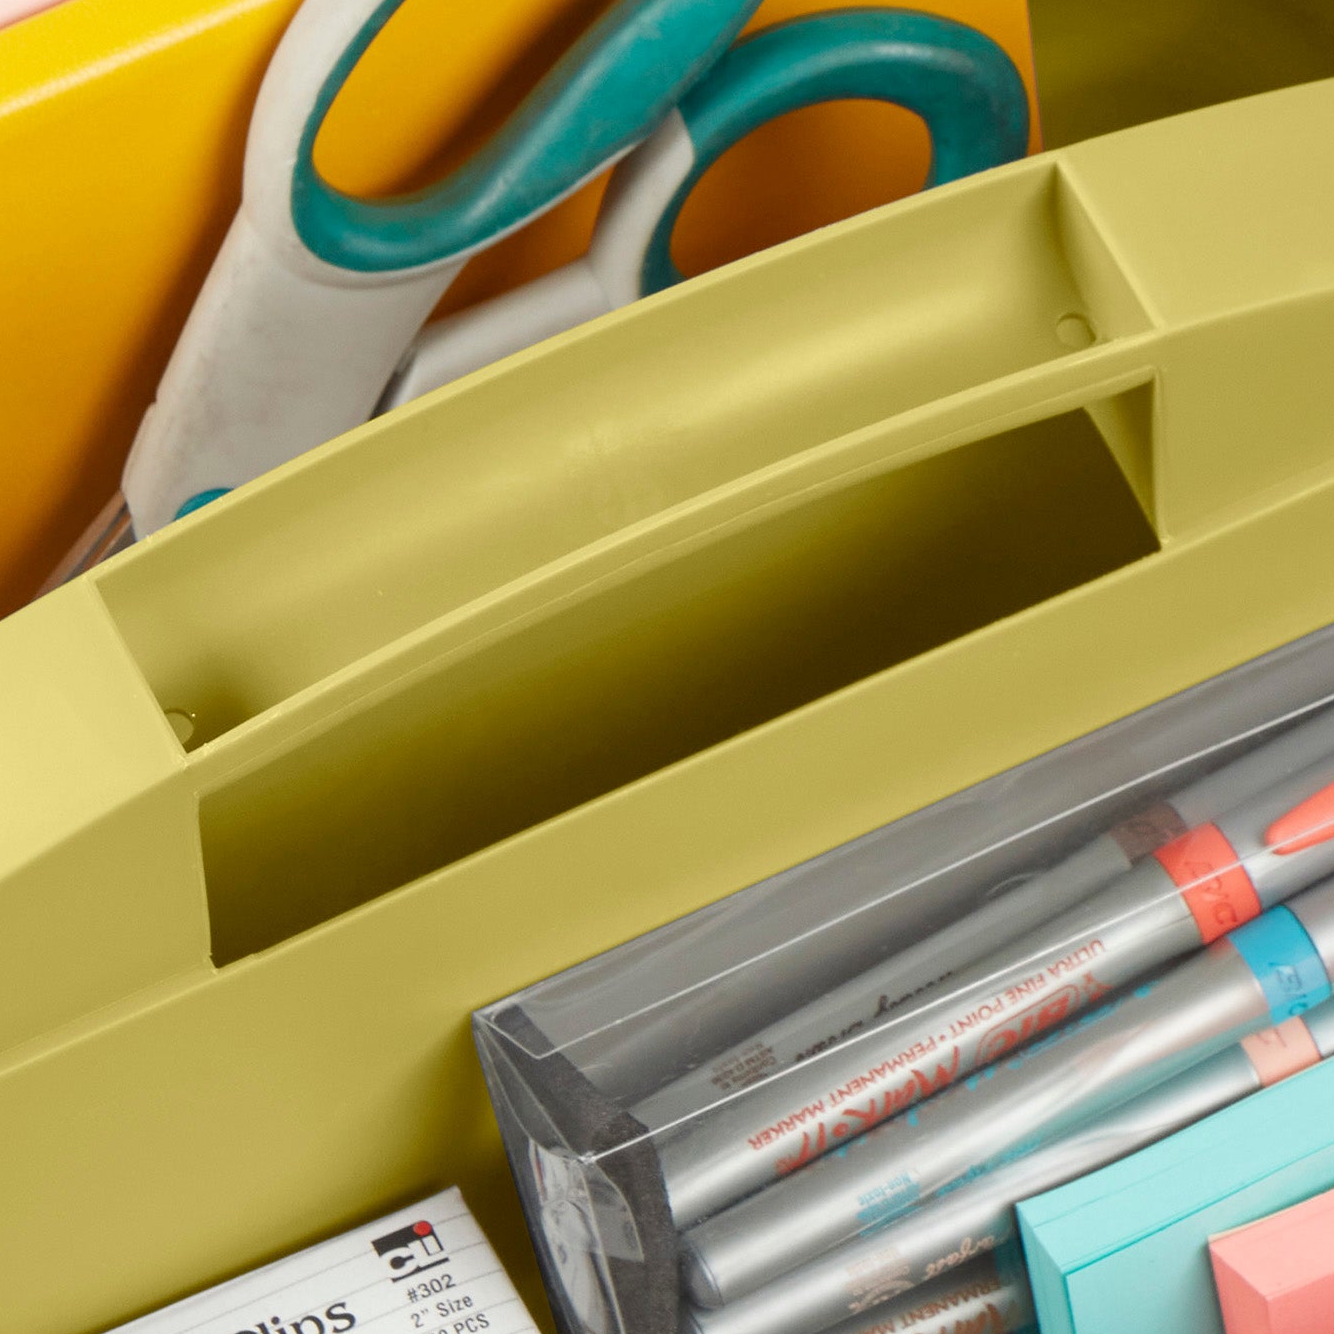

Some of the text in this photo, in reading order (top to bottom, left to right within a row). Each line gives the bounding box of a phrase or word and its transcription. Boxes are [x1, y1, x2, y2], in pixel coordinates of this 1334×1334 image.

[1045, 938, 1105, 977] ULTRA
[1002, 969, 1047, 1003] FINE
[949, 991, 1005, 1037] POINT
[828, 1039, 937, 1107] PERMANENT
[748, 1100, 825, 1151] MARKER
[407, 1273, 456, 1303] #302
[436, 1295, 474, 1318] Size
[902, 1276, 1003, 1331] ERMANENT
